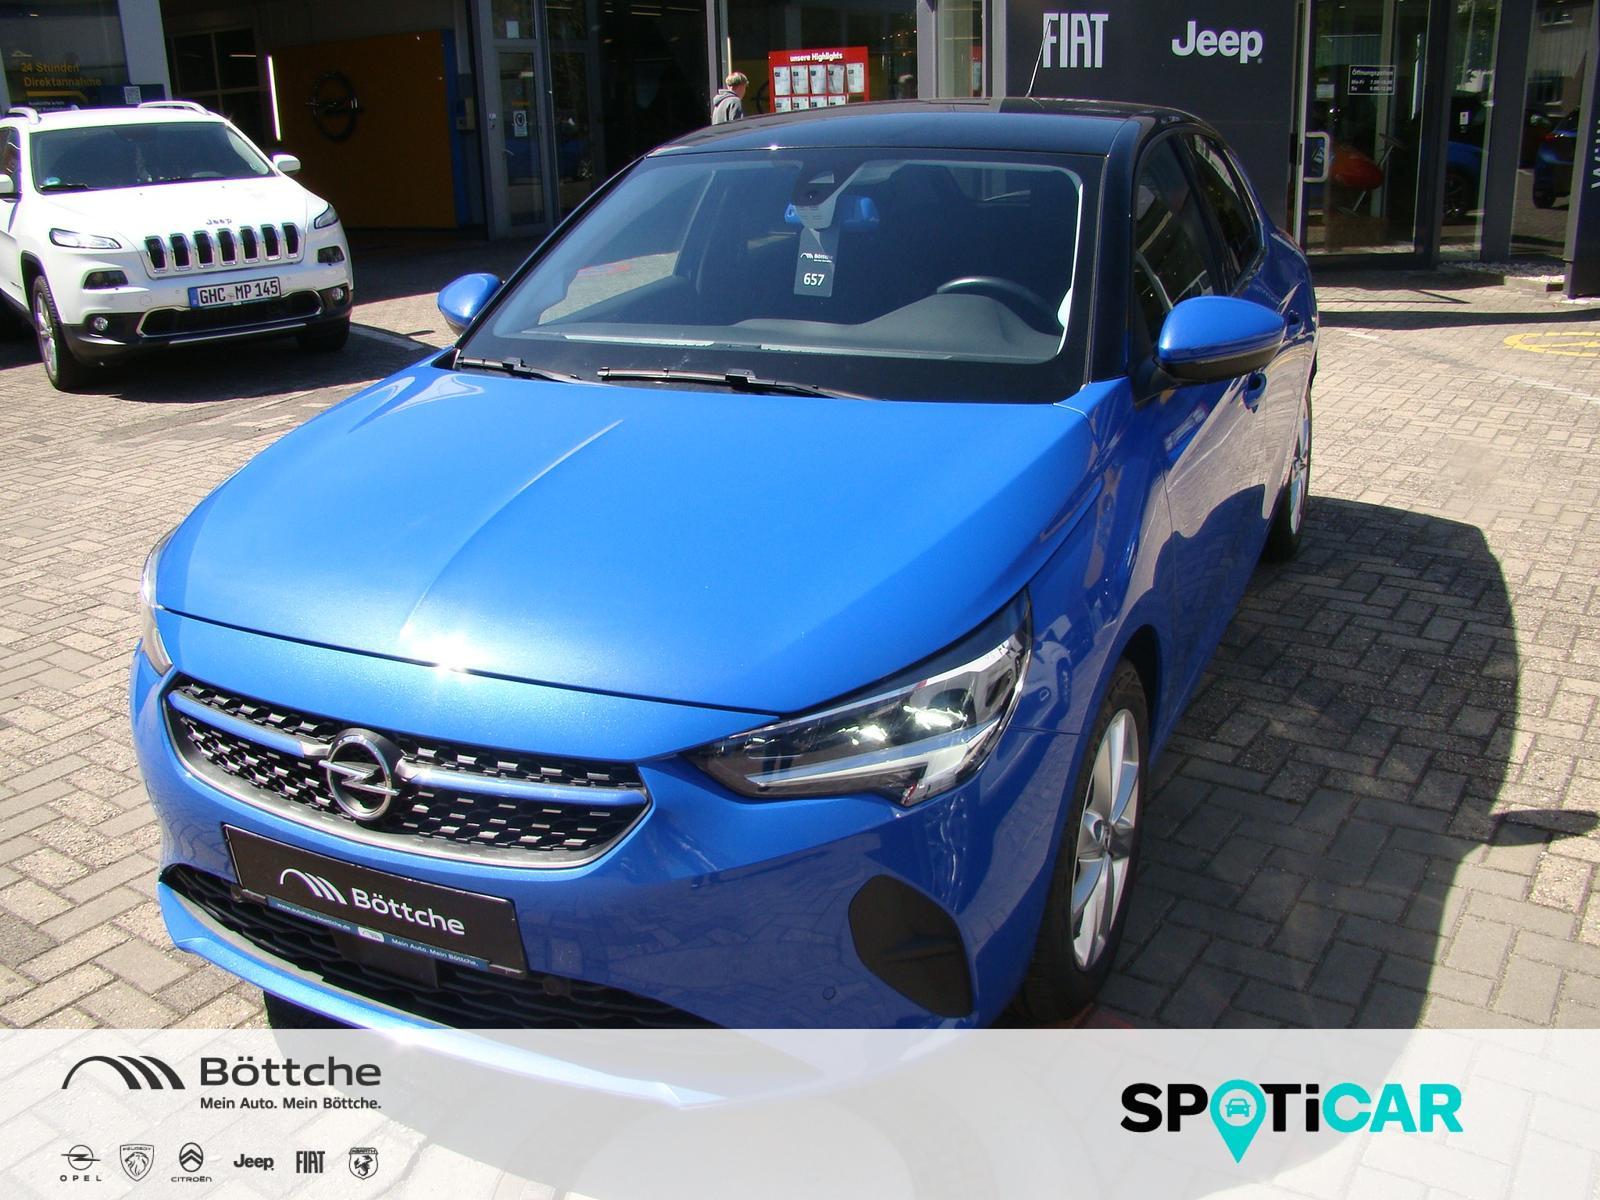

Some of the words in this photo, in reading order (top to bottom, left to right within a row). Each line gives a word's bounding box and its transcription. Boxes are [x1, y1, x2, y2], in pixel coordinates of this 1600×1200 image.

[1042, 13, 1109, 68] FIAT
[1171, 20, 1264, 64] Jeep
[811, 52, 843, 62] Highlights
[21, 63, 33, 72] 24
[36, 63, 81, 73] Stunden
[24, 77, 102, 88] Direktannahme
[803, 273, 825, 286] 657
[199, 287, 226, 305] GHC
[235, 283, 252, 300] MP
[255, 280, 278, 297] 145
[351, 887, 466, 936] Böttche
